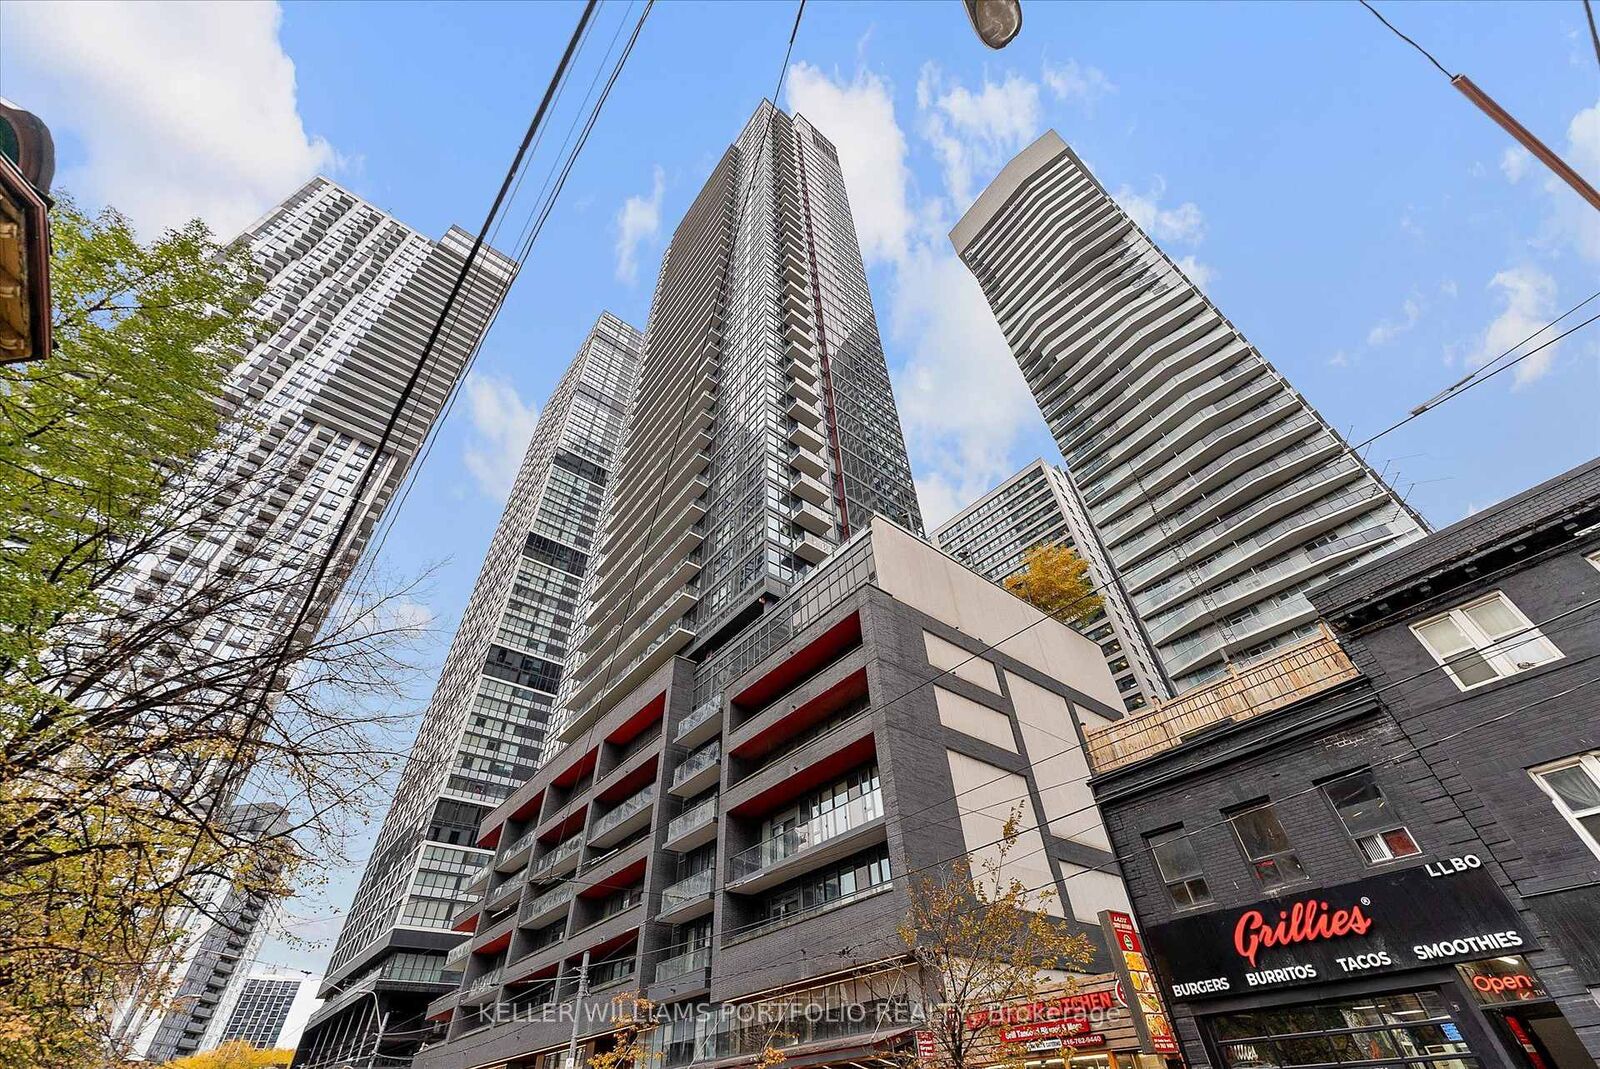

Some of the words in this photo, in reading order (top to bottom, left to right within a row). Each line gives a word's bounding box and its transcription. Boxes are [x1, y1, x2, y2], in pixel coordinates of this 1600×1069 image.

[1425, 854, 1482, 878] LLBO
[1234, 900, 1372, 968] Grillies
[1172, 977, 1230, 997] BURGERS
[1245, 964, 1317, 987] BURRITOS
[1336, 951, 1392, 972] TACOS
[1413, 930, 1523, 960] SMOOTHIES
[1473, 974, 1533, 995] Open
